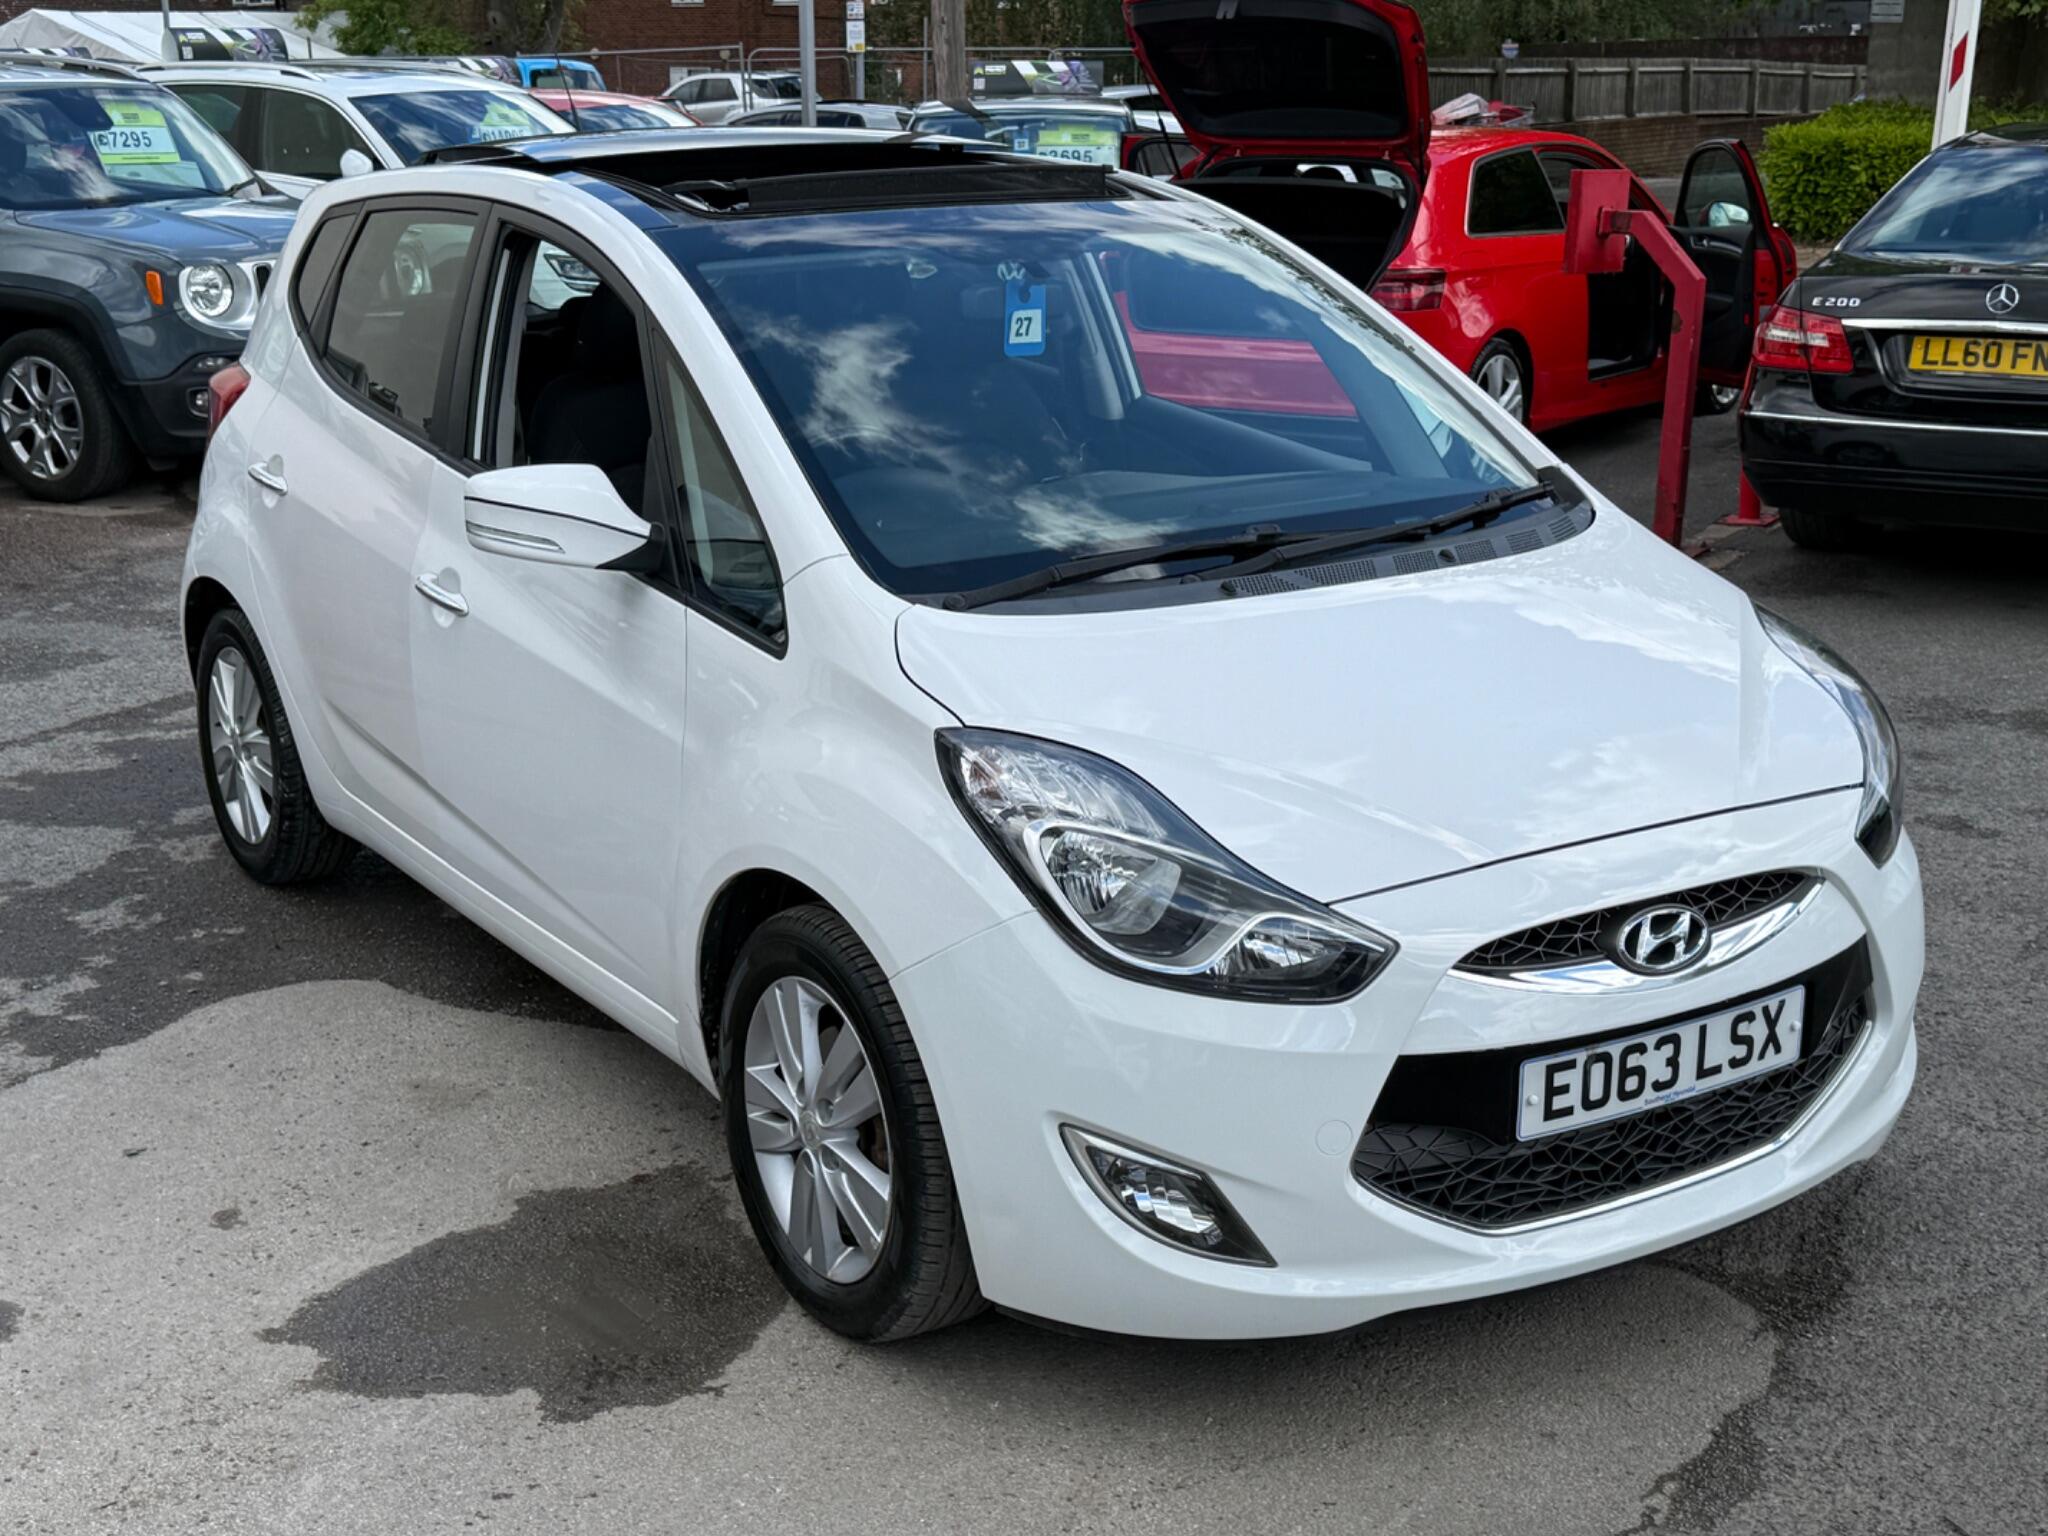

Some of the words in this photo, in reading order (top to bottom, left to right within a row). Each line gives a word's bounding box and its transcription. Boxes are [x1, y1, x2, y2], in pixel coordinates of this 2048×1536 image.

[1812, 297, 1822, 306] E
[1825, 297, 1861, 307] 200
[1014, 316, 1033, 338] 27
[1921, 338, 2001, 369] LL60
[1543, 1032, 1682, 1122] EO63
[1695, 998, 1786, 1081] LSX
